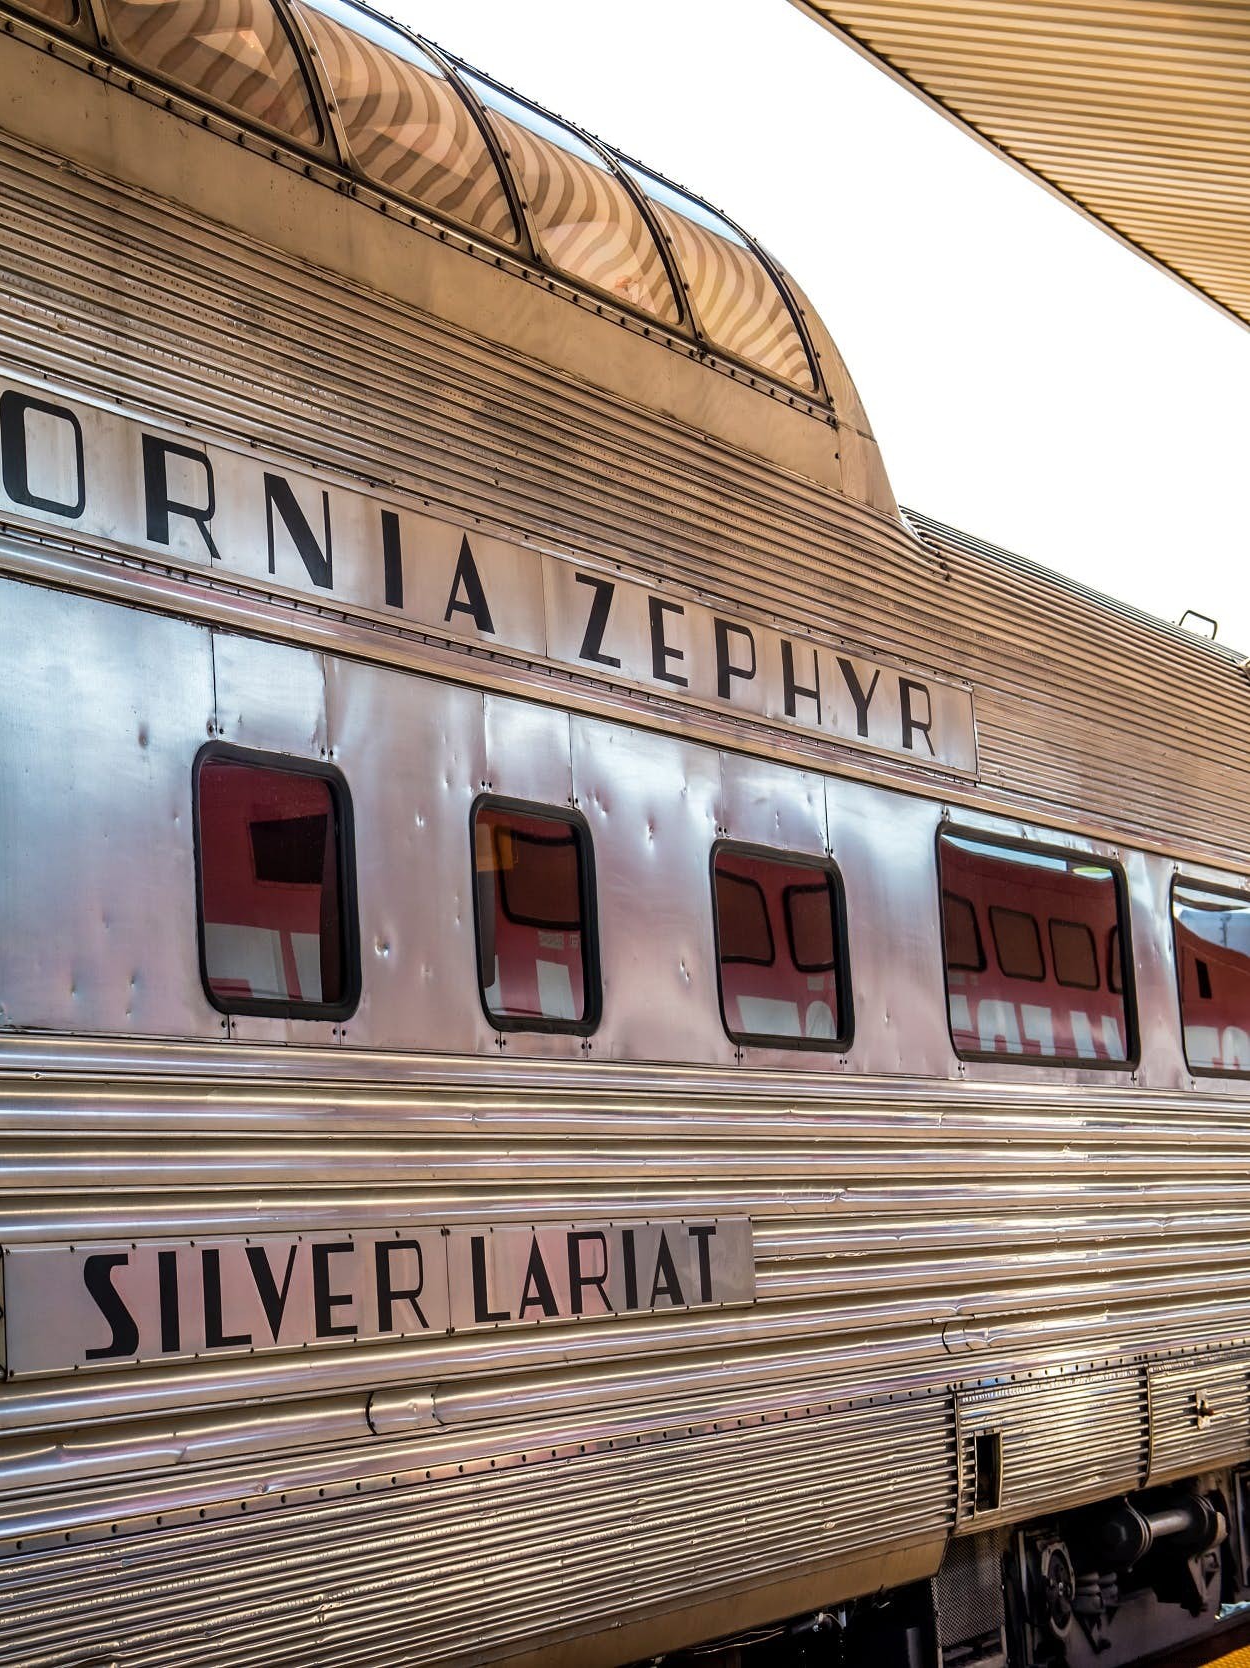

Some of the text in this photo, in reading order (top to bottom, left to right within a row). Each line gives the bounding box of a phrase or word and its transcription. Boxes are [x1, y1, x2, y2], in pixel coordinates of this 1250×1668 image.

[575, 572, 936, 757] ZEPHYR
[84, 1226, 717, 1361] SILVER LARIAT
